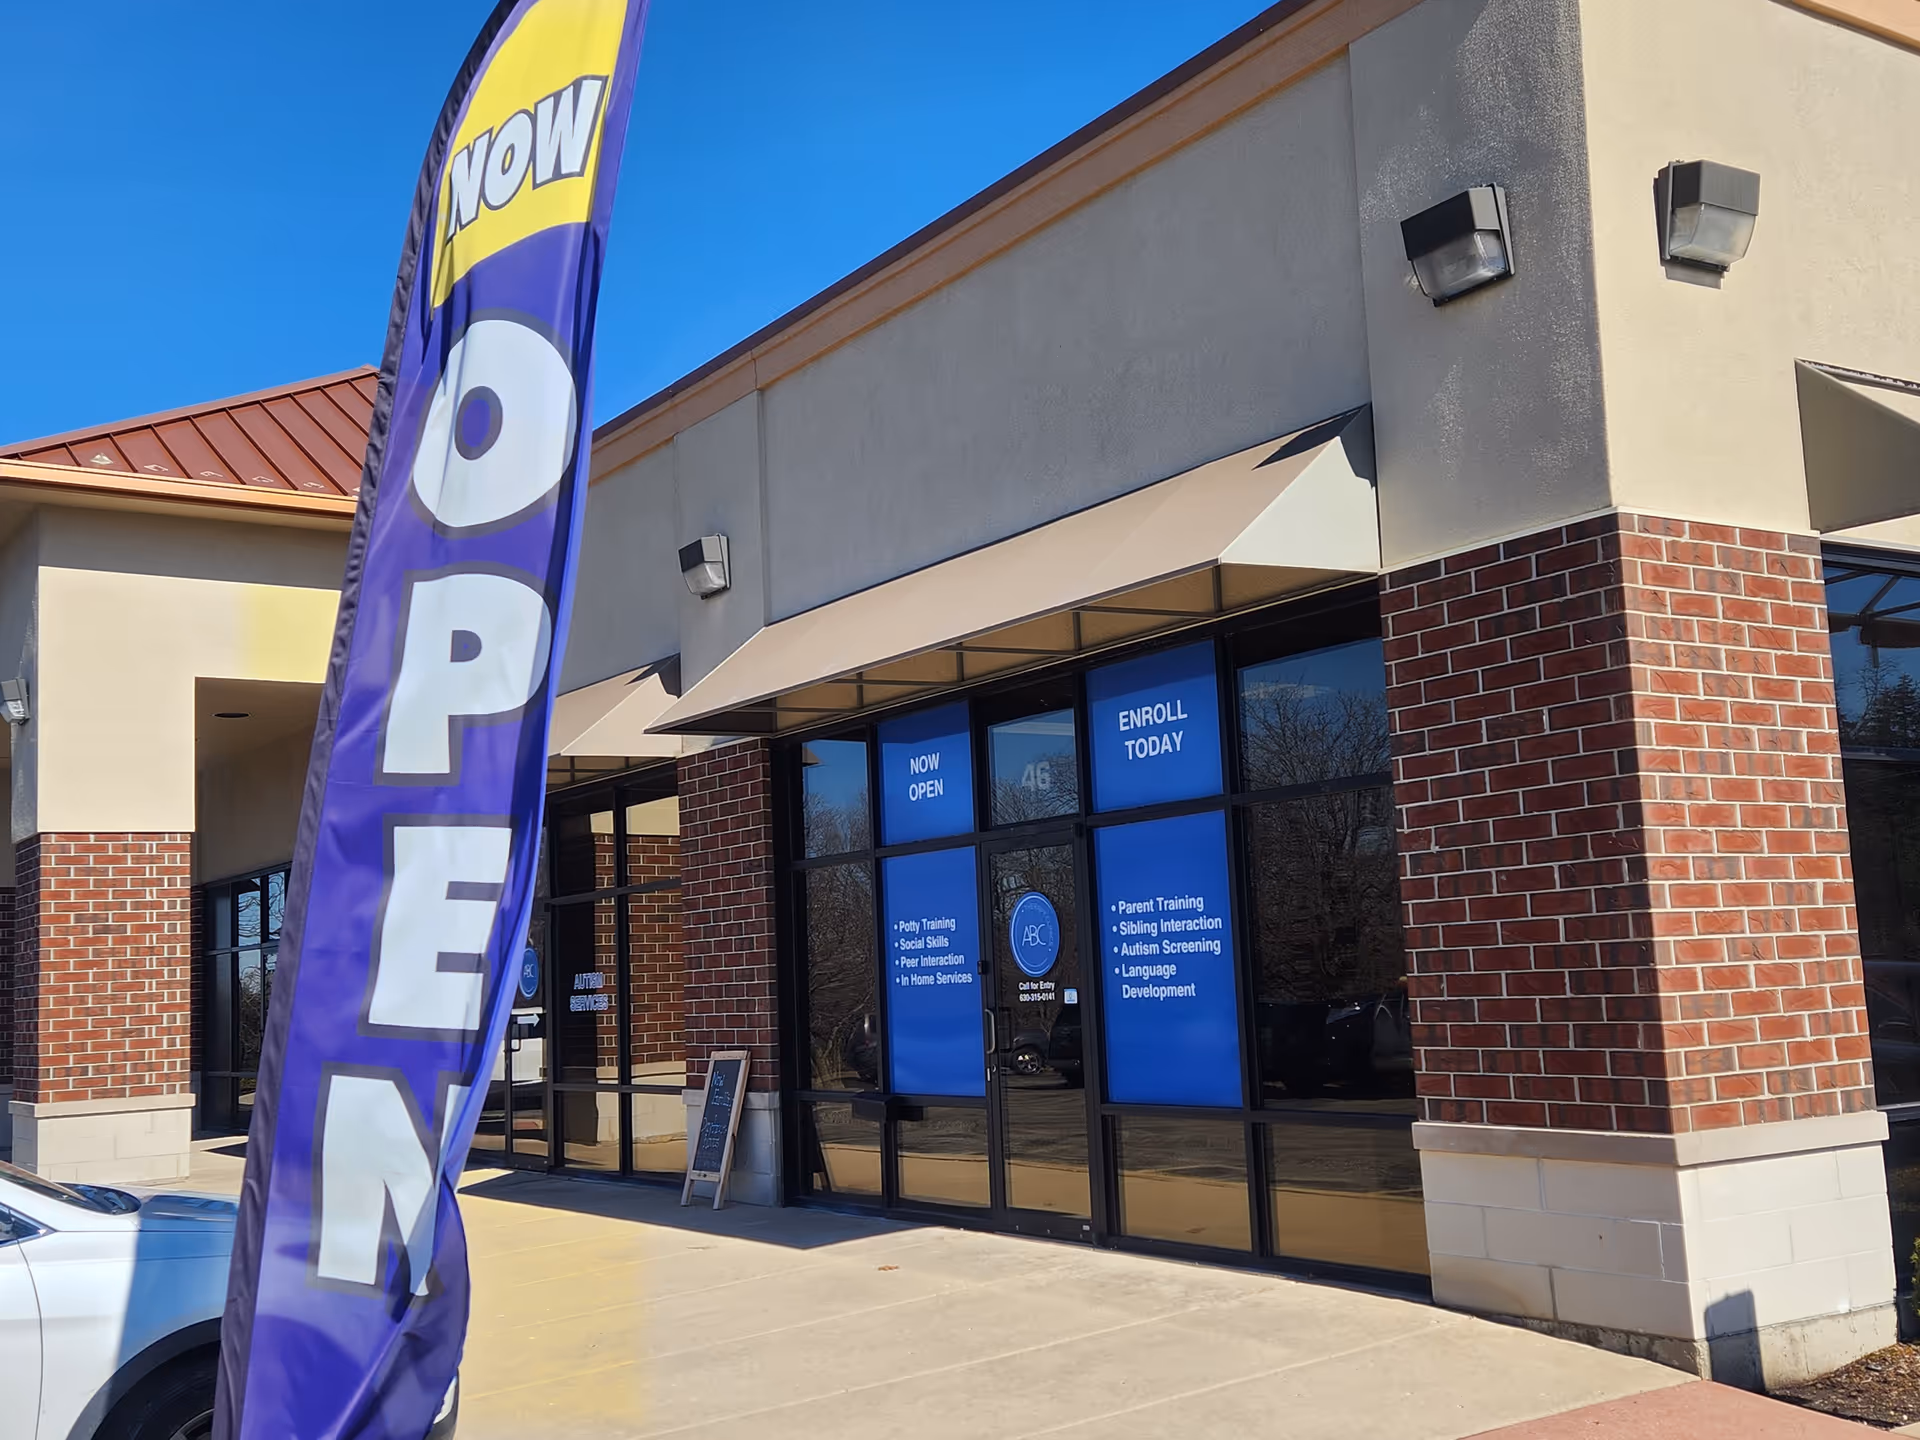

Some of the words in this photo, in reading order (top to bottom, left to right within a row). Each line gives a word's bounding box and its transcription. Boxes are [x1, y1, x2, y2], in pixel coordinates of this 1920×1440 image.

[445, 76, 608, 242] NOW
[1118, 699, 1188, 732] ENROLL
[1124, 730, 1184, 761] TODAY
[910, 751, 940, 775] NOW
[1021, 761, 1051, 791] 46
[908, 778, 944, 802] OPEN
[316, 317, 580, 1299] OPEN
[1118, 898, 1154, 915] Parent
[1156, 894, 1204, 912] Training
[899, 919, 920, 935] Potty
[921, 916, 956, 932] Training
[1021, 923, 1047, 947] ABC
[1119, 919, 1158, 937] Sibling
[1160, 915, 1222, 933] Interaction
[899, 936, 925, 951] Social
[926, 935, 949, 949] Skills
[1121, 941, 1160, 957] Autism
[1162, 937, 1221, 955] Screening
[900, 955, 920, 969] Peer
[920, 952, 965, 967] Interaction
[573, 972, 604, 990] AUTISM
[901, 973, 910, 987] In
[910, 973, 935, 986] Home
[936, 970, 973, 985] Services
[1121, 963, 1177, 980] Language
[1018, 981, 1030, 990] Call
[1030, 981, 1039, 990] for
[1039, 980, 1056, 991] Entry
[1122, 982, 1196, 1002] Development
[569, 993, 609, 1012] SERVICES
